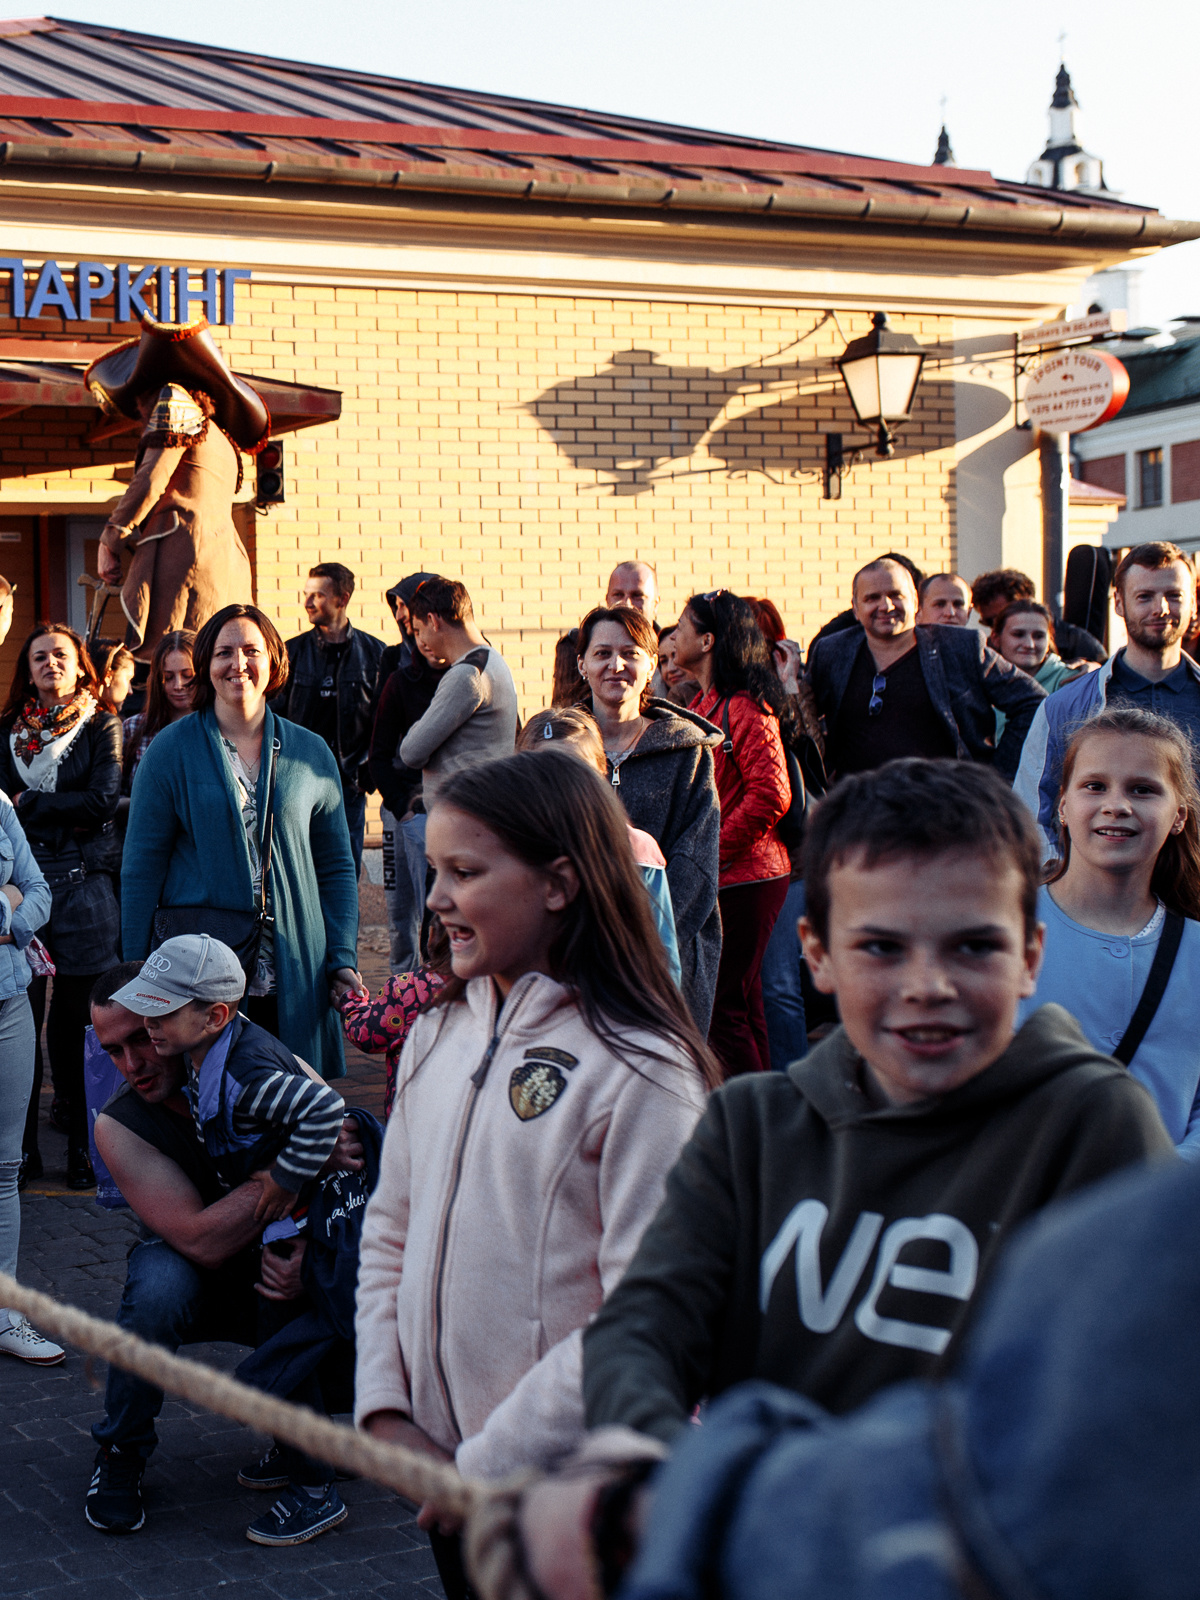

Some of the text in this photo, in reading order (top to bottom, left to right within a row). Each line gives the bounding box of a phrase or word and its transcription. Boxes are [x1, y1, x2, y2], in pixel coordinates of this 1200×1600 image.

[1074, 355, 1102, 372] TOUR
[1065, 399, 1079, 409] 777
[382, 830, 397, 891] PUNCH
